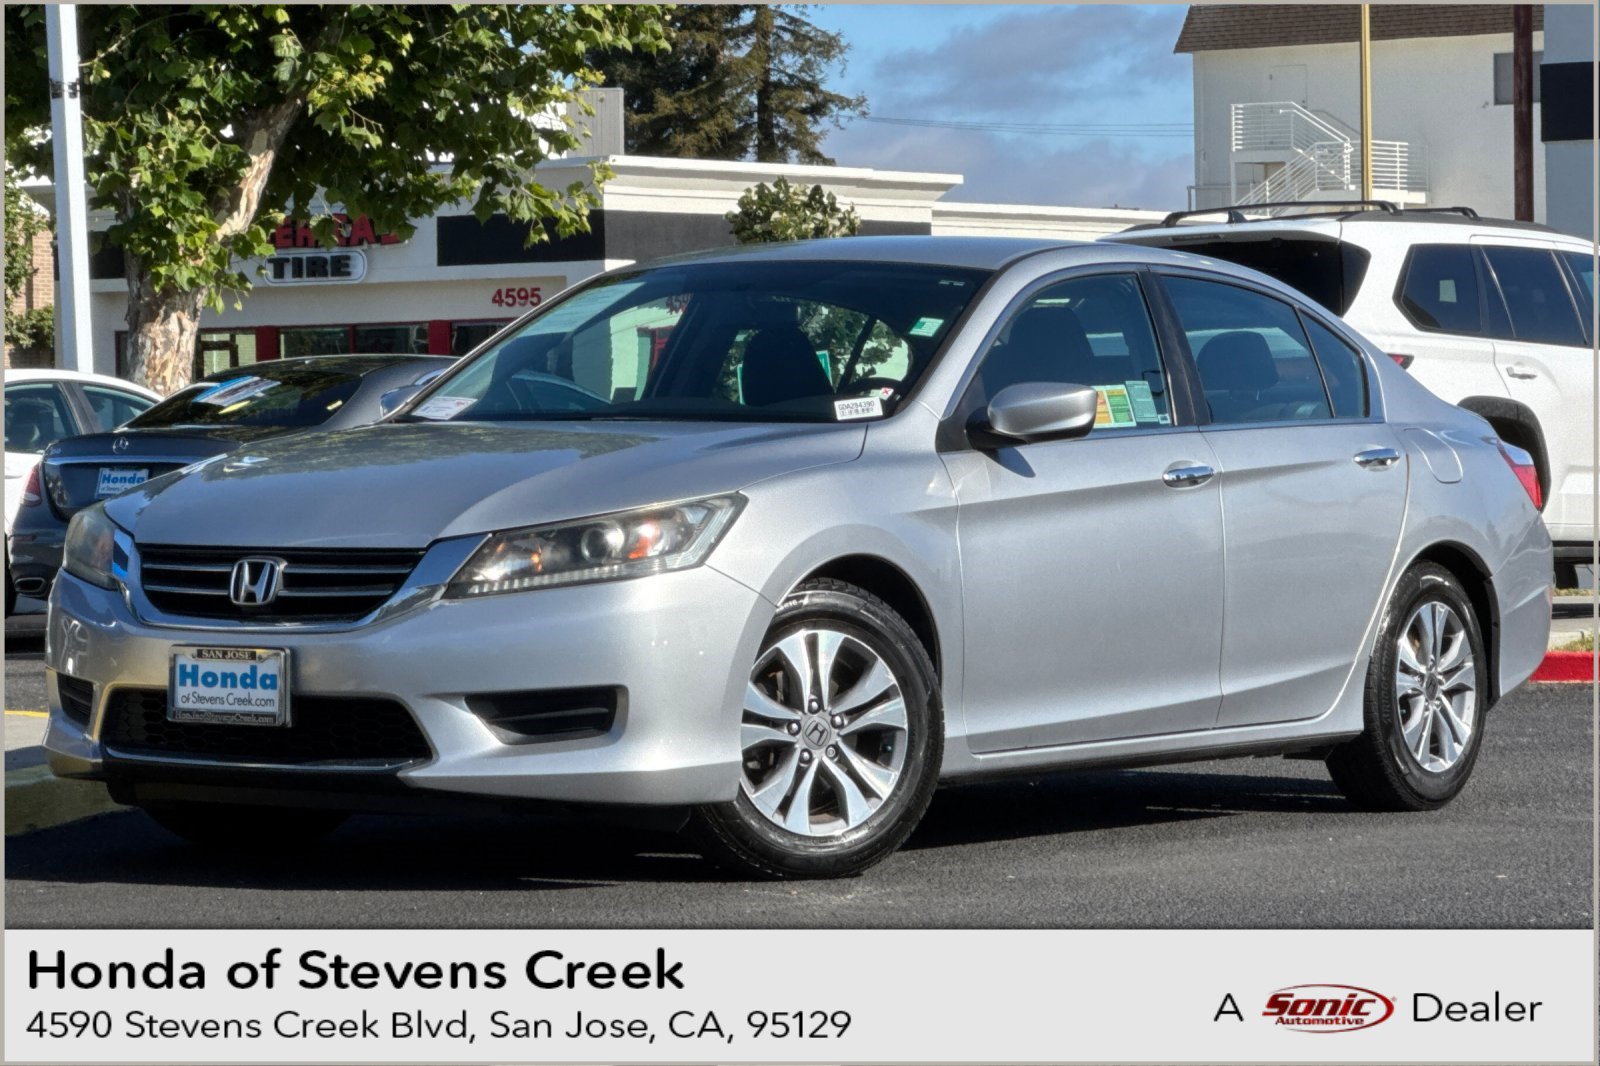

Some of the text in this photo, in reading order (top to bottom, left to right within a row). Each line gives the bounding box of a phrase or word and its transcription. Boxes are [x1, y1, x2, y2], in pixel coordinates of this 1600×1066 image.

[267, 255, 352, 279] TIRE
[492, 287, 542, 307] 4595
[101, 474, 145, 485] Honda
[201, 649, 252, 660] SAN JOSE
[179, 663, 278, 690] Honda
[180, 691, 275, 708] of Stevens Creek.com
